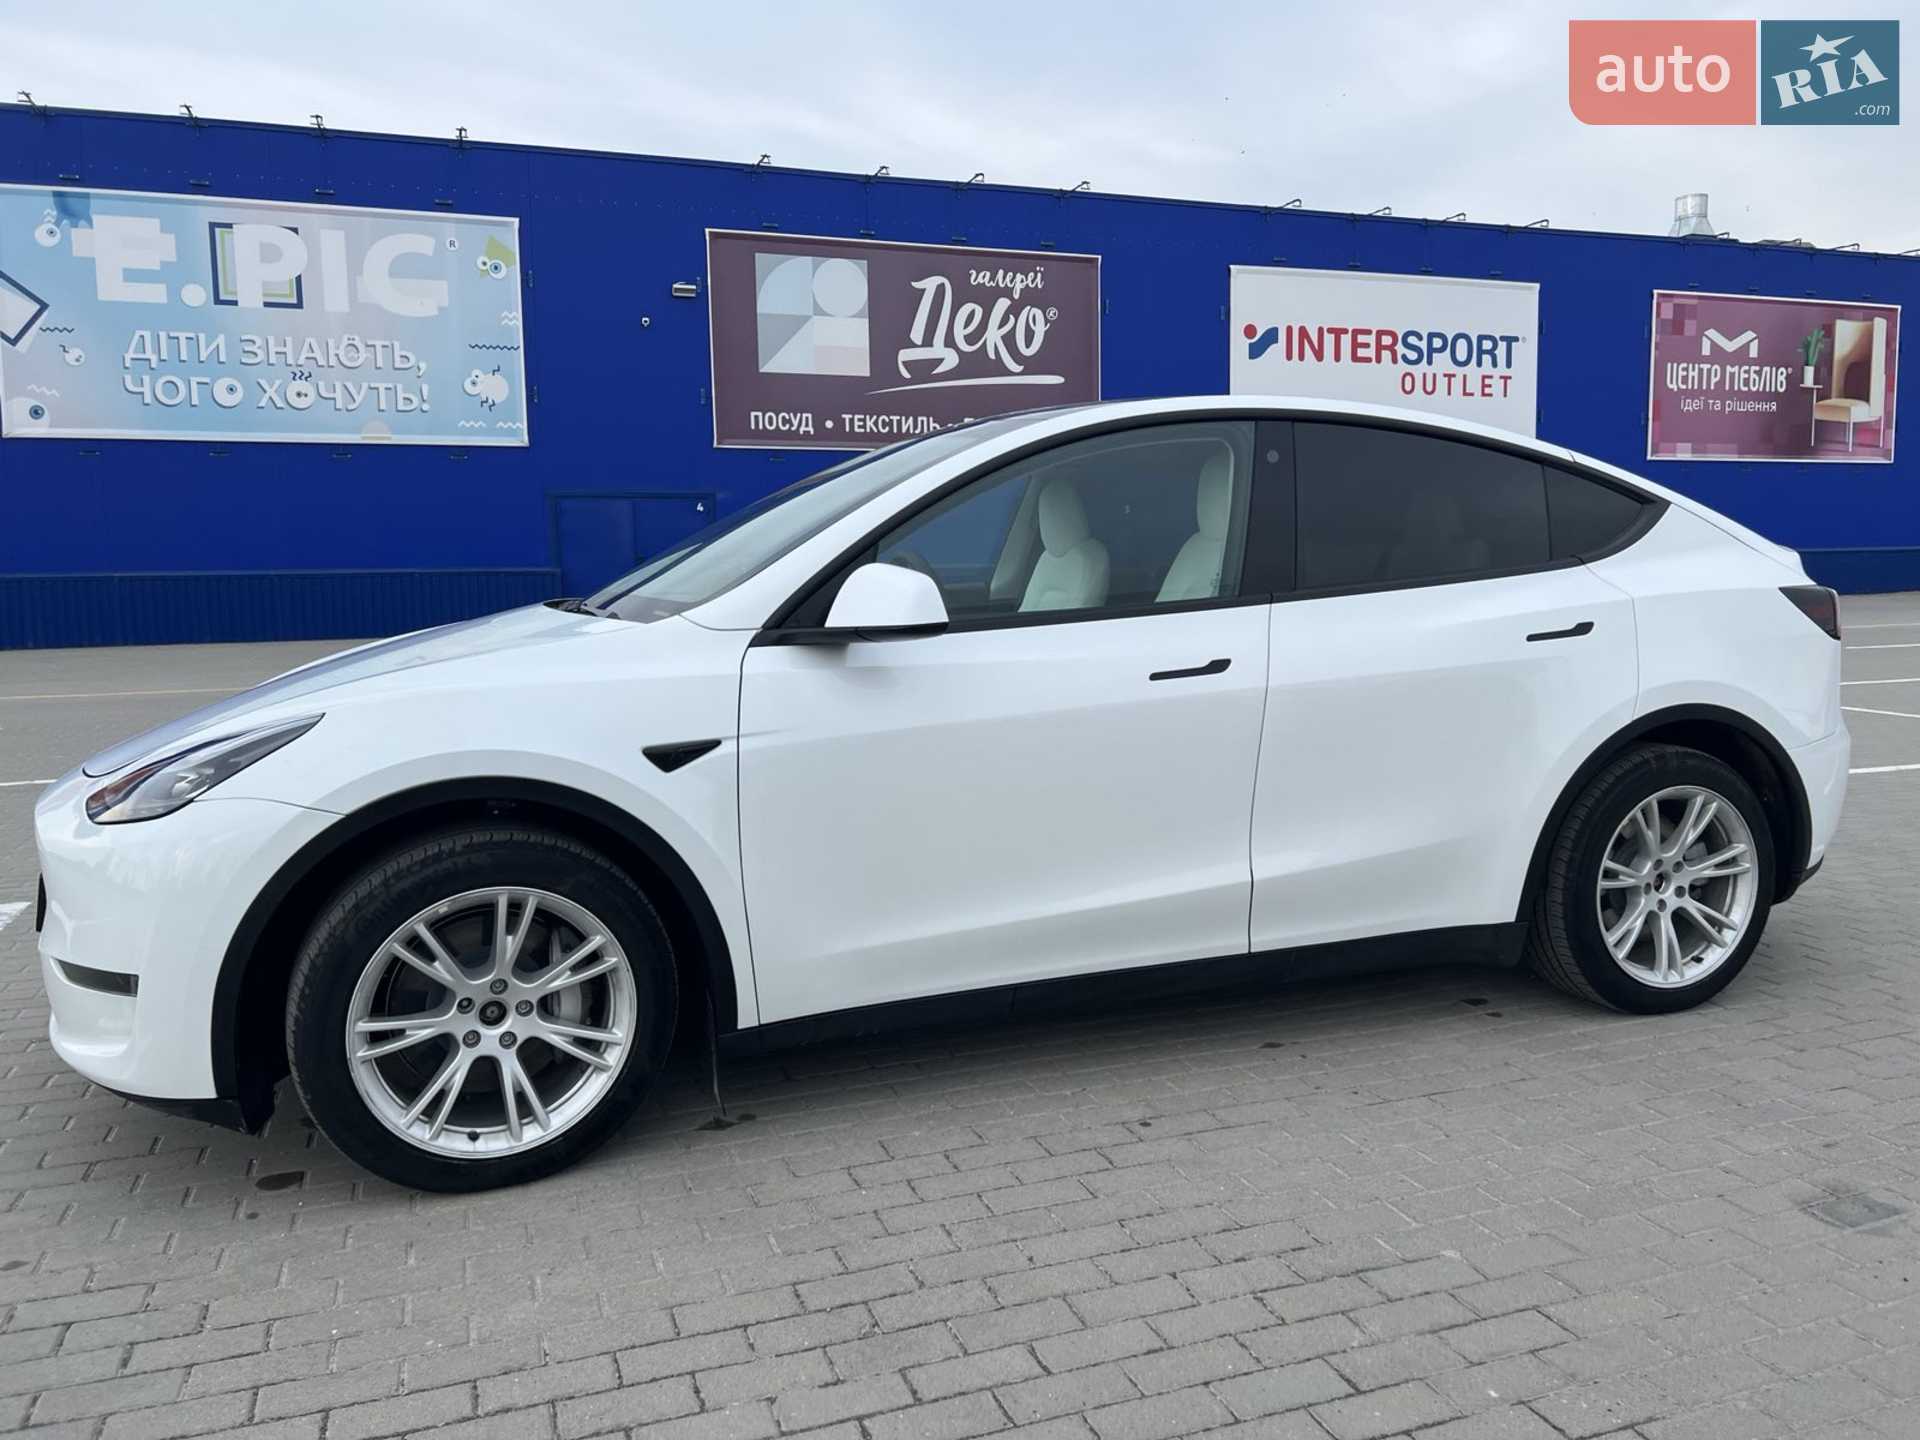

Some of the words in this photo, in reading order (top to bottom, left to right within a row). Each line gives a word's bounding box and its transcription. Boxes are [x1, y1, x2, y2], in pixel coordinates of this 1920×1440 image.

[88, 213, 441, 318] E.PIC
[969, 266, 1044, 299] галереї
[897, 275, 1050, 379] Деко
[123, 329, 227, 369] ДІТИ
[1285, 324, 1520, 369] INTERSPORT
[123, 374, 244, 408] ЧОГО
[256, 375, 431, 413] ХОЧУТЬ!
[1400, 371, 1513, 398] OUTLET
[1666, 362, 1721, 392] ЦЕНТР
[1725, 364, 1788, 393] МЕБЛІВ
[749, 411, 815, 435] ПОСУД
[841, 413, 941, 434] ТЕКСТИЛЬ
[1680, 396, 1705, 413] ідеї
[1708, 399, 1721, 411] та
[1725, 398, 1777, 415] рішення
